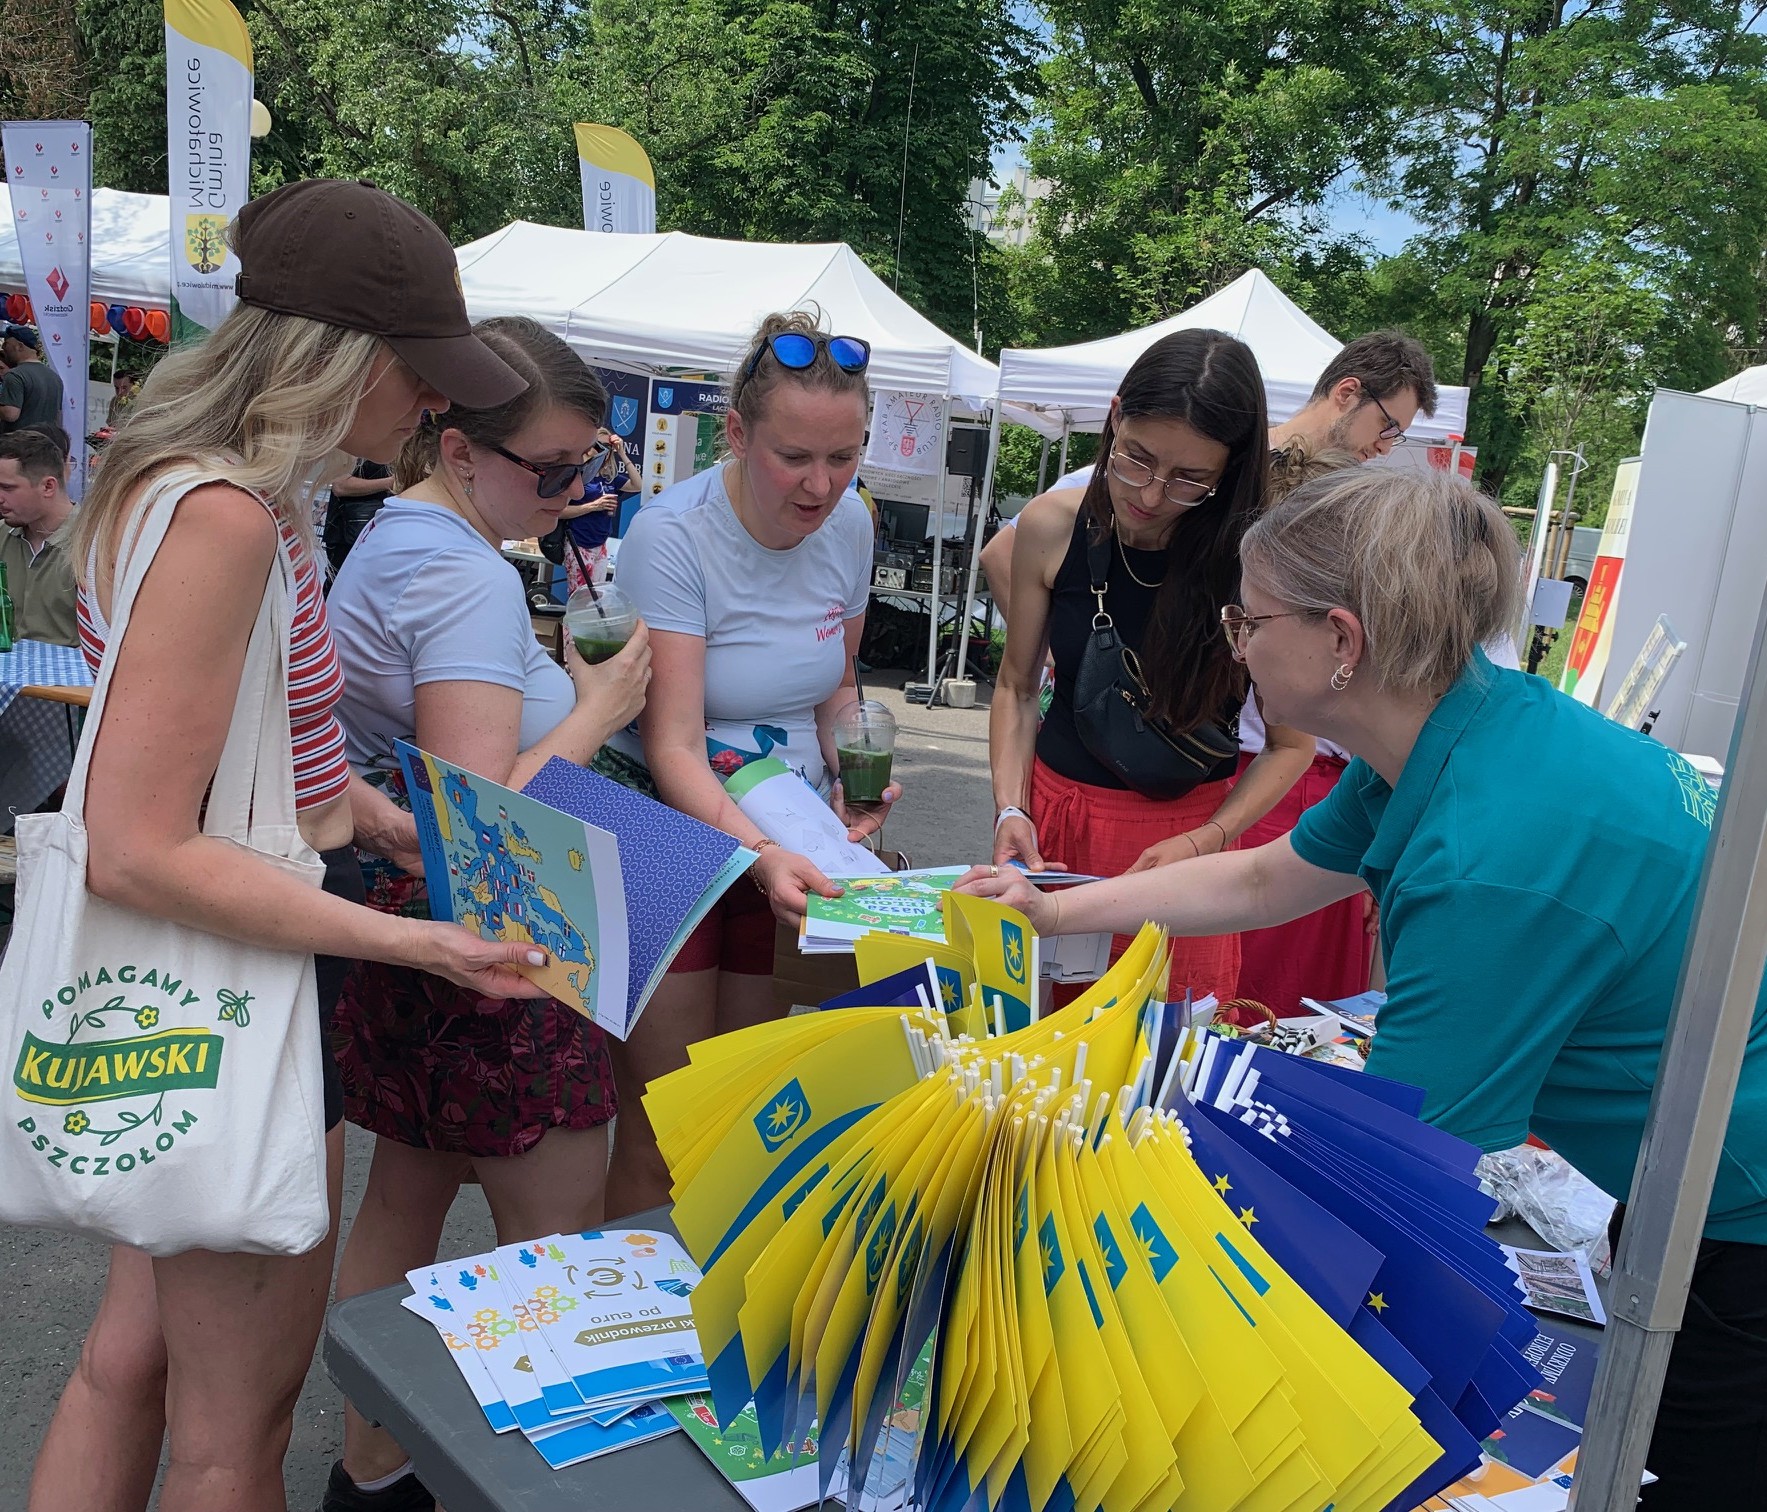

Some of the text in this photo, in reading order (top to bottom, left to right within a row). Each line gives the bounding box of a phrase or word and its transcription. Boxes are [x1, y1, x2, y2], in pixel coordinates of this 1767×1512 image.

[699, 393, 730, 404] RADIO
[886, 391, 928, 410] AMATEUR
[929, 399, 942, 431] RADIO
[916, 435, 937, 455] CLUB
[42, 965, 201, 1020] POMAGAMY
[20, 1042, 209, 1093] KUJAWSKI
[17, 1109, 199, 1176] PSZCZOŁOM
[590, 1306, 662, 1324] po euro
[584, 1319, 696, 1343] ki przewodnik
[1540, 1342, 1577, 1385] ODKRYJMY
